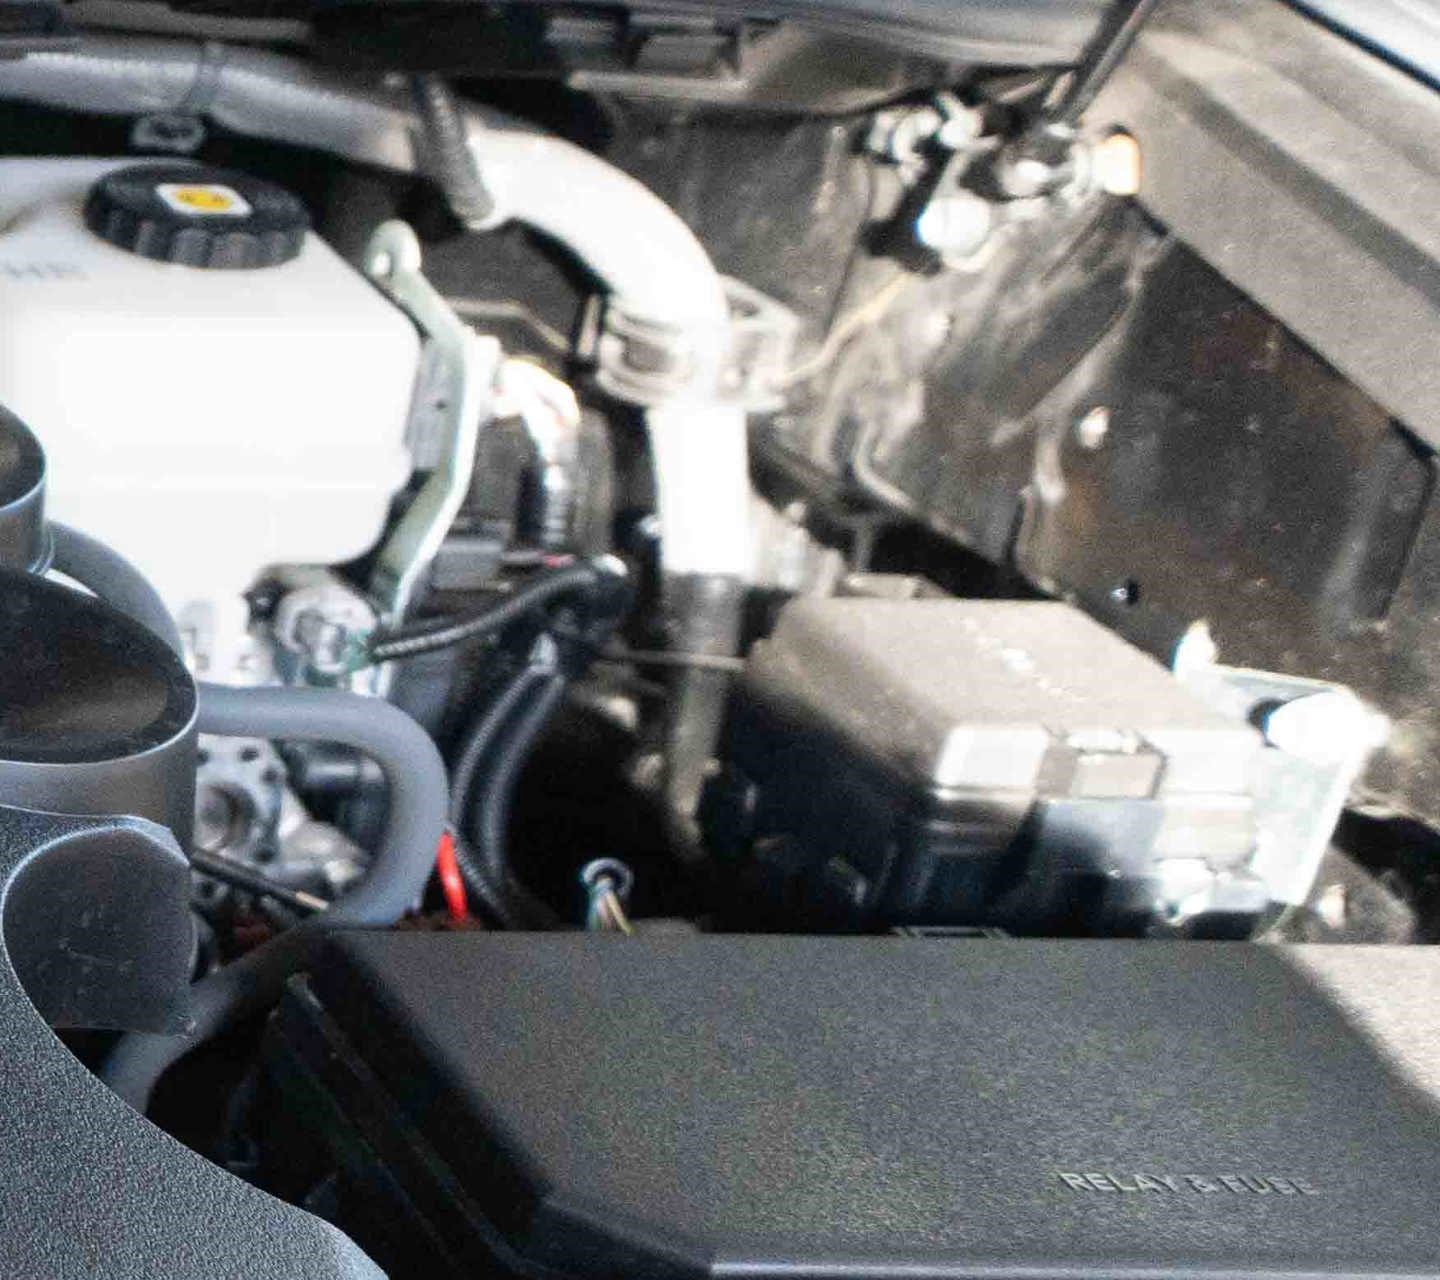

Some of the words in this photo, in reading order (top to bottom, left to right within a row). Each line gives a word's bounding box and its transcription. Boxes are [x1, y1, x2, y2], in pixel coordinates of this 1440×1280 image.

[1057, 1171, 1180, 1194] RELAY
[1185, 1173, 1218, 1194] &
[1218, 1174, 1320, 1195] FUSE
